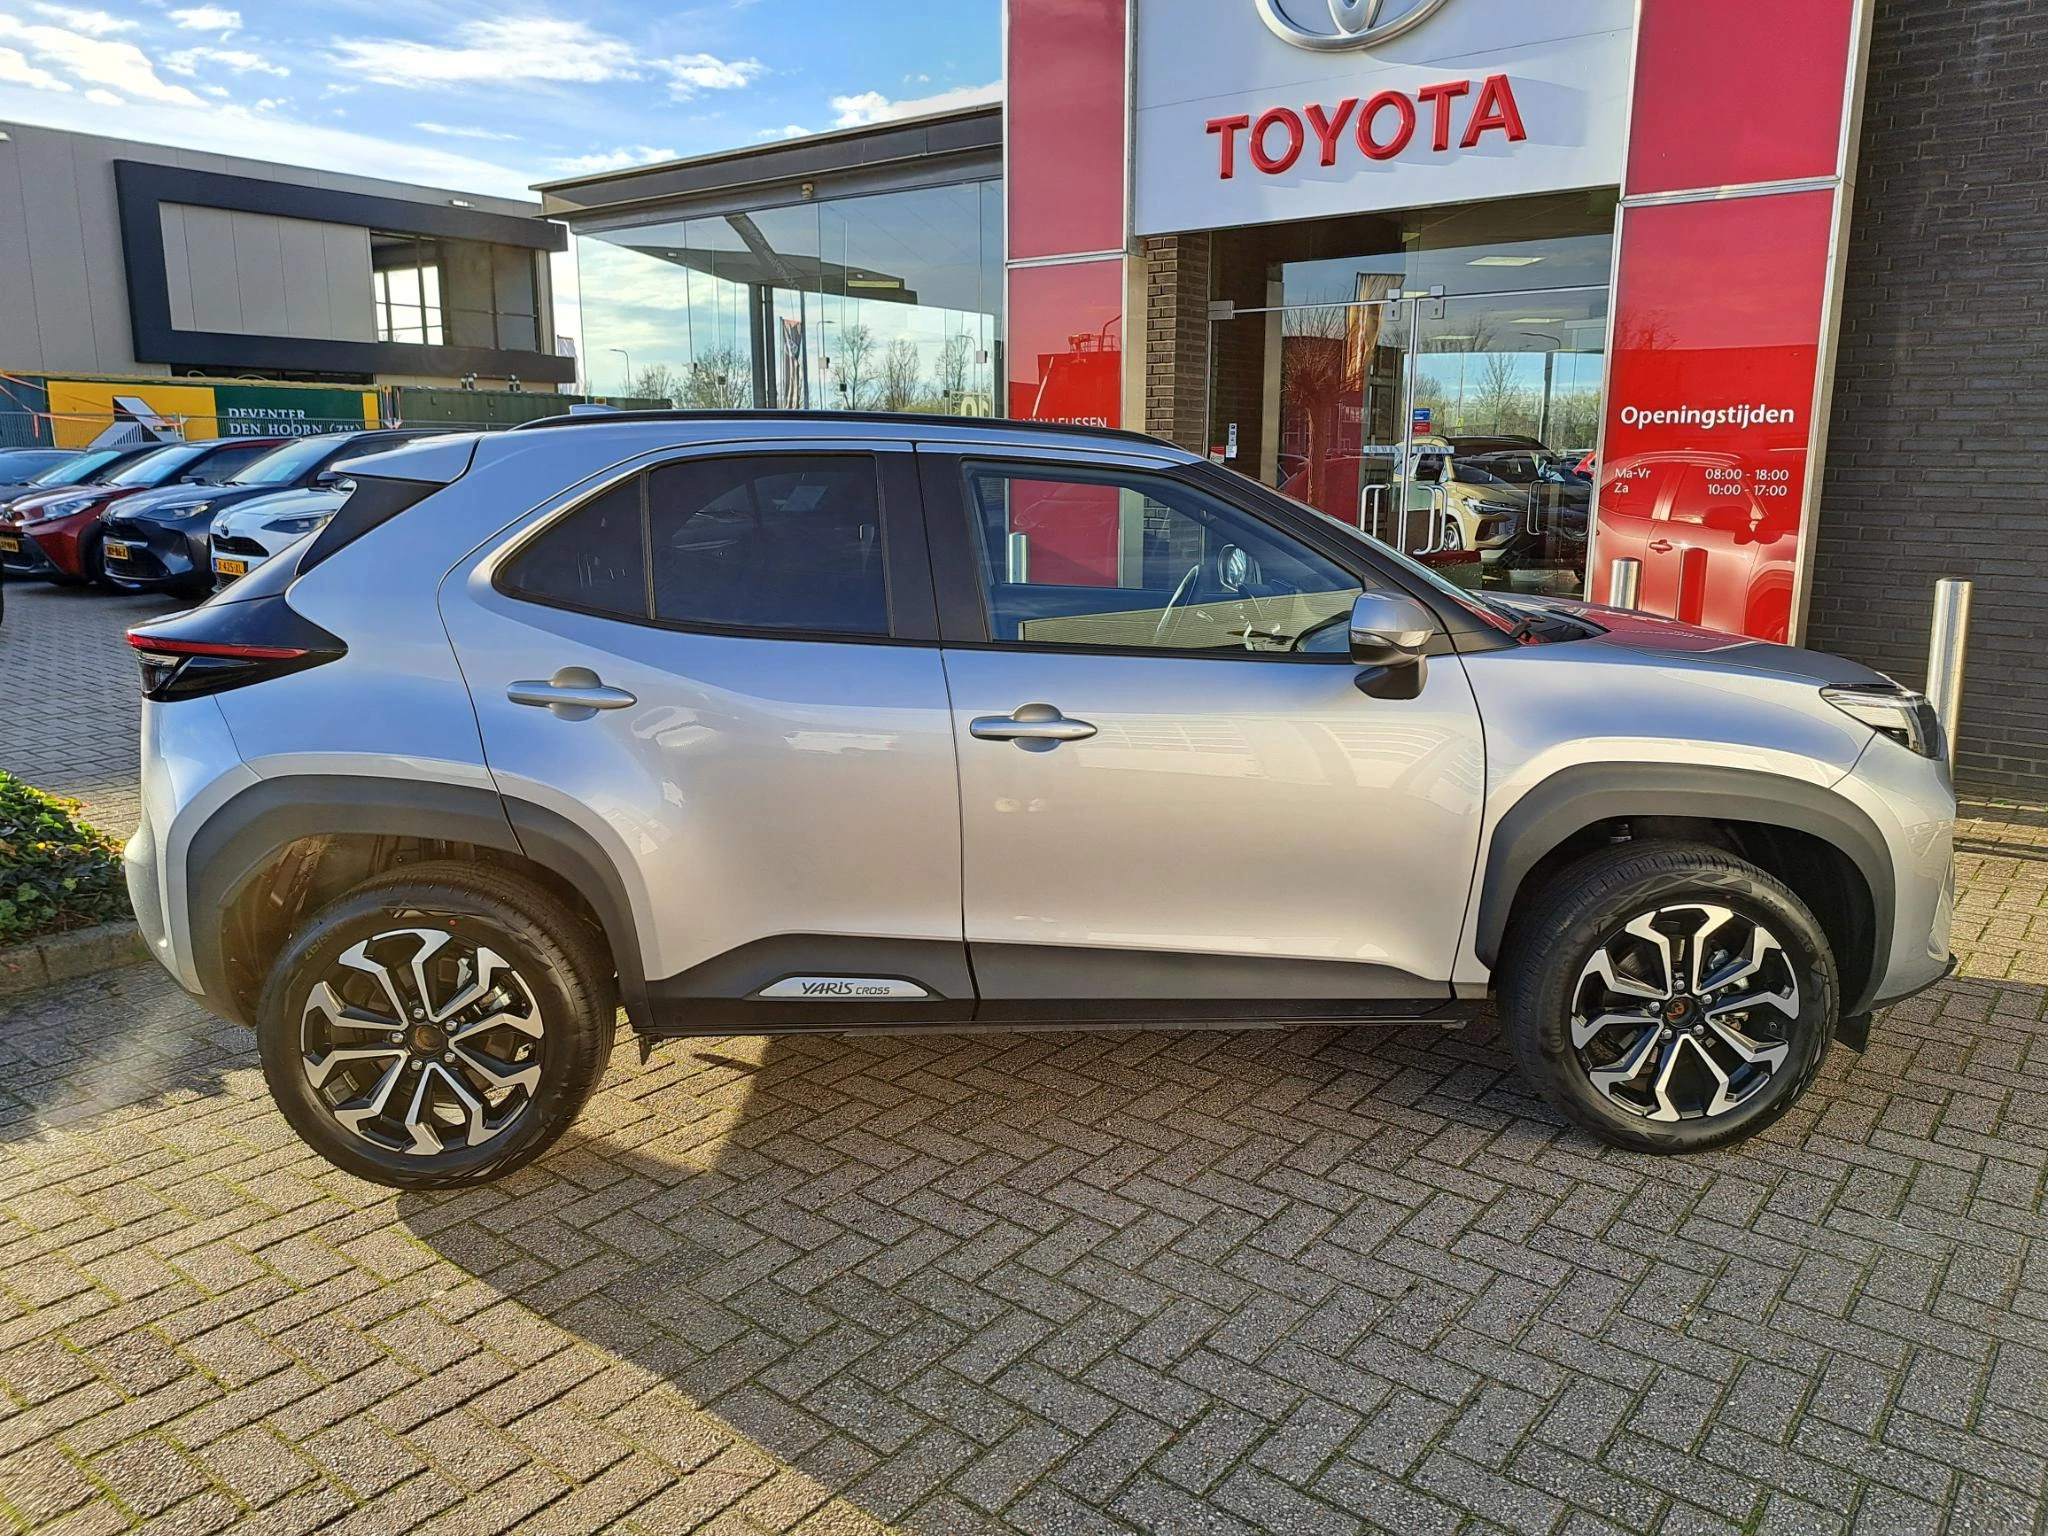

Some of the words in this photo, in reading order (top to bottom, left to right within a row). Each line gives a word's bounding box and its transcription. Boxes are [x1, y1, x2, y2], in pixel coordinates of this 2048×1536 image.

[1205, 73, 1527, 179] TOYOTA
[228, 408, 306, 420] DEVENTER
[1620, 404, 1795, 430] Openingstijden
[229, 423, 261, 435] DEN
[268, 424, 323, 436] HOORN
[1614, 467, 1651, 480] Ma-Vr
[1705, 468, 1743, 481] 08:00
[1755, 469, 1789, 482] 18:00
[1614, 482, 1629, 494] Za
[1707, 483, 1741, 496] 10:00
[1753, 484, 1788, 497] 17:00
[855, 986, 890, 995] CROSS
